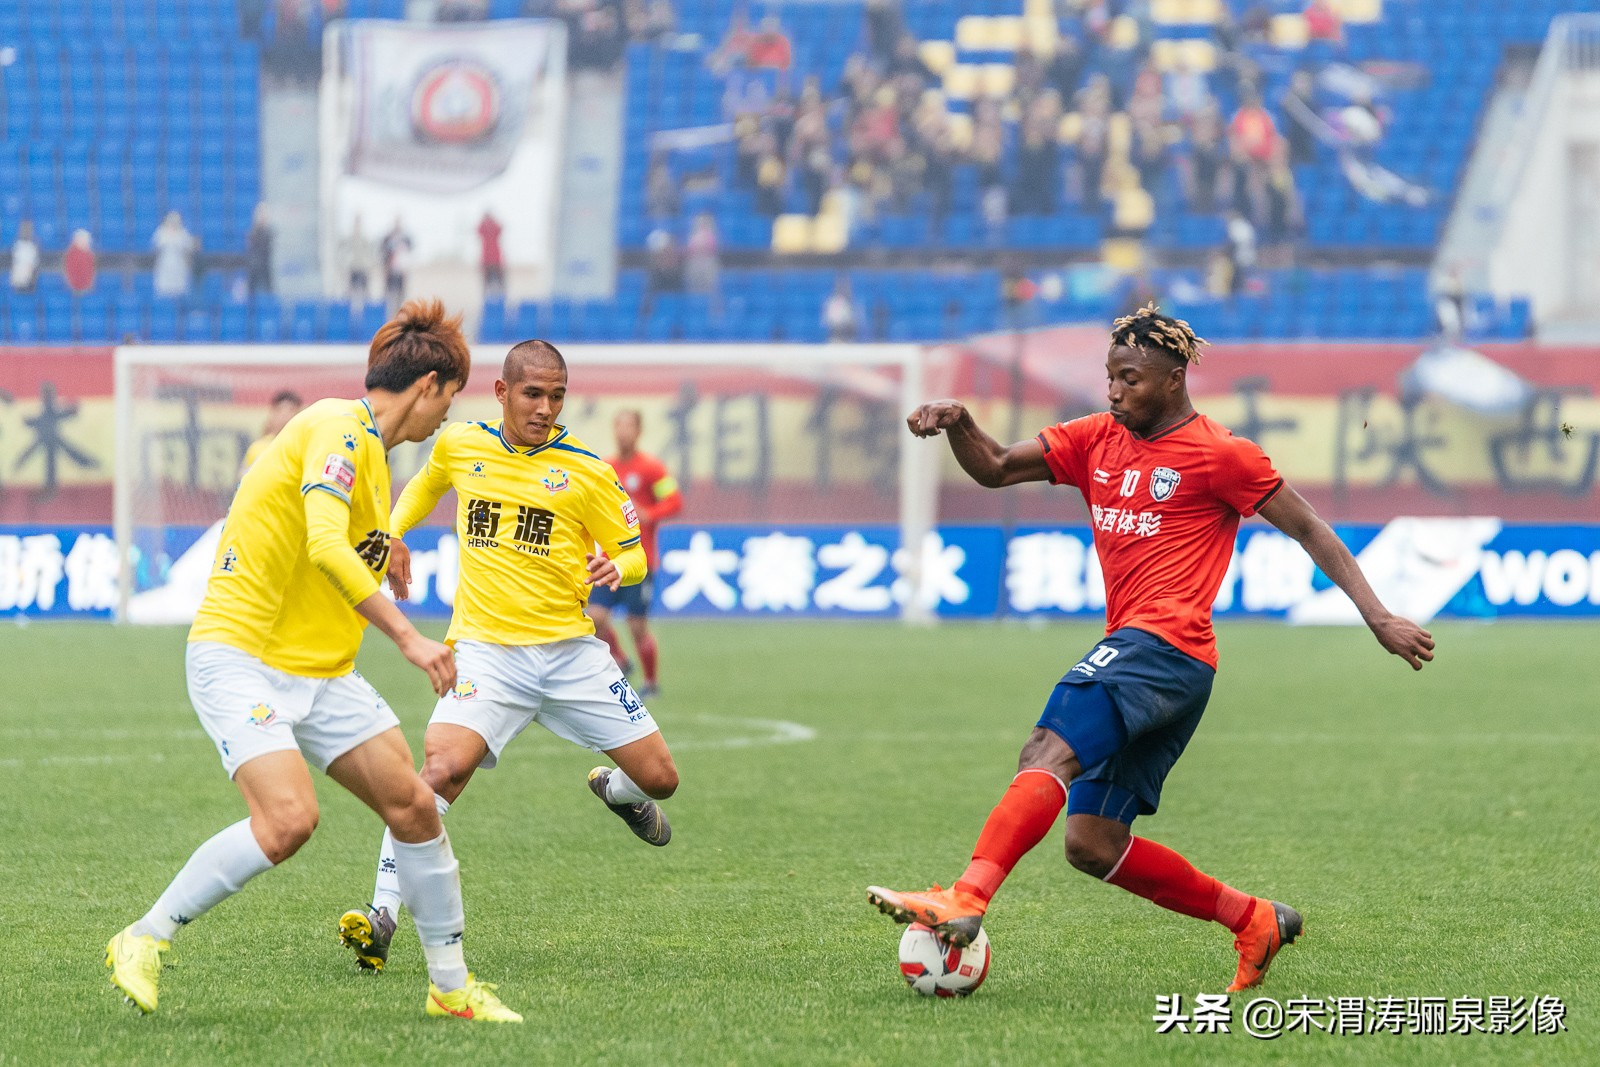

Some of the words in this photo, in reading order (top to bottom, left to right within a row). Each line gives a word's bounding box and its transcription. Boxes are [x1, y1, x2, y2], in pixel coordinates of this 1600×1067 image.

[1120, 469, 1141, 498] 10
[1091, 503, 1163, 537] 陕西体彩
[467, 538, 499, 548] HENG
[514, 544, 550, 557] YUAN
[1088, 645, 1119, 667] 10
